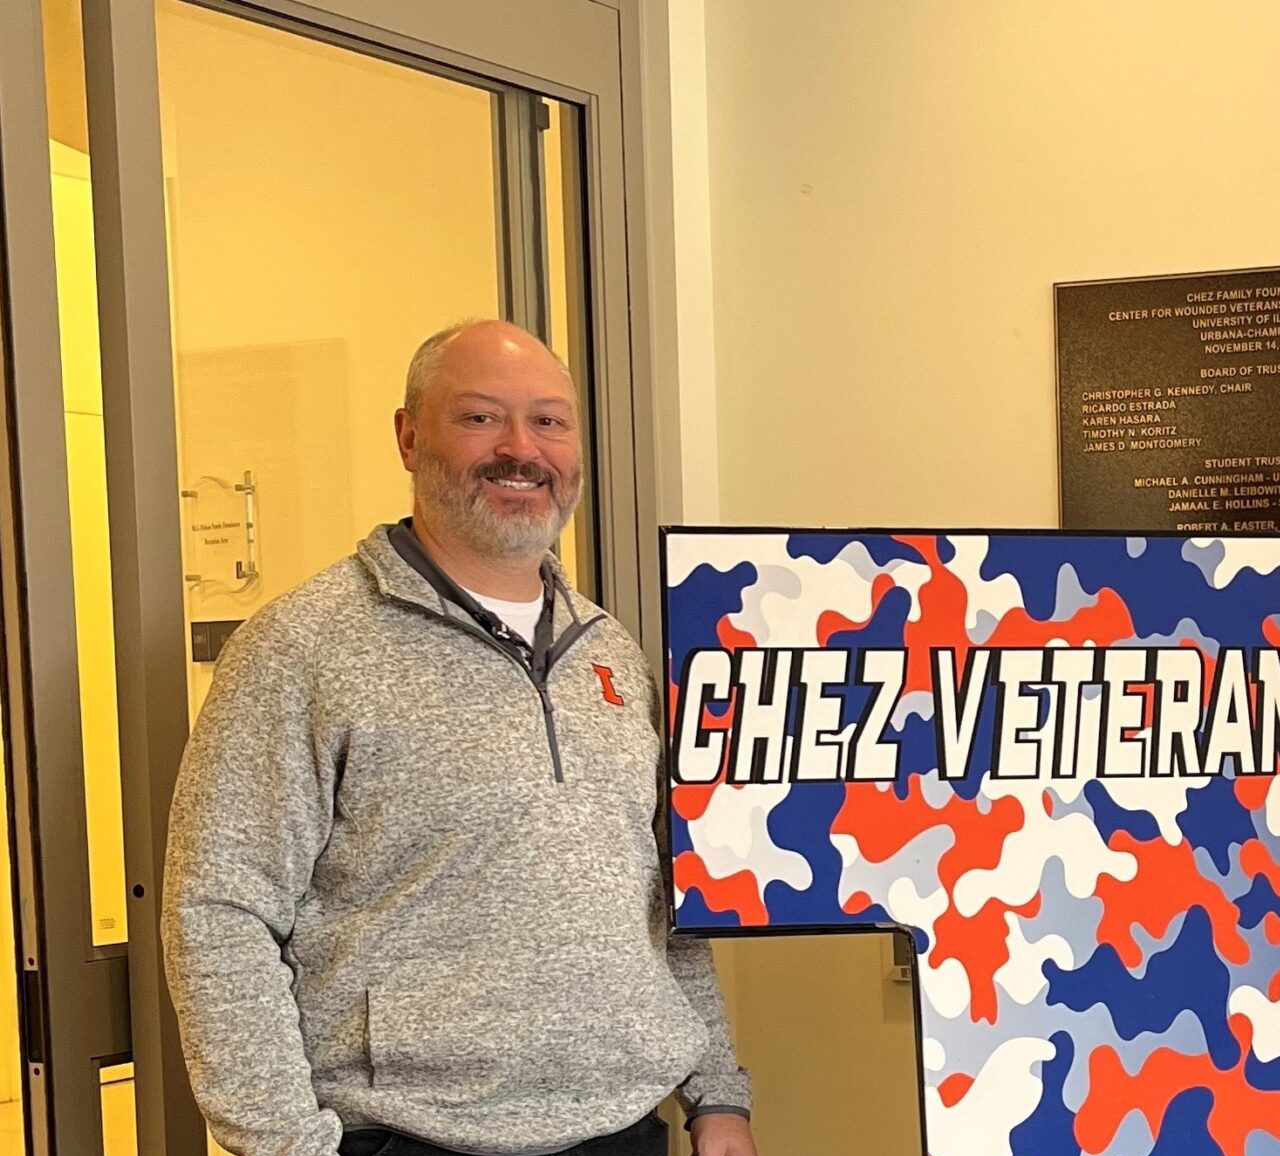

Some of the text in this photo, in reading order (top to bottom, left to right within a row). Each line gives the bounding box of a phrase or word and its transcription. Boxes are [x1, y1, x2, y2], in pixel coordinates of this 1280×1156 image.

[1186, 292, 1214, 303] CHEZ
[1216, 288, 1253, 300] FAMILY
[1108, 309, 1149, 322] CENTER
[1151, 307, 1172, 318] FOR
[1174, 304, 1227, 317] WOUNDED
[1192, 315, 1253, 329] UNIVERSITY
[1255, 314, 1270, 325] OF
[1204, 341, 1263, 354] NOVEMBER
[1265, 340, 1280, 351] 14,
[1200, 366, 1237, 379] BOARD
[1239, 365, 1253, 376] OF
[1081, 388, 1151, 402] CHRISTOPHER
[1220, 382, 1252, 393] CHAIR
[1081, 400, 1177, 414] RICARDO ESTRADA
[1081, 414, 1161, 427] KAREN HASARA
[1082, 428, 1125, 440] TIMOTHY
[1140, 426, 1178, 437] KORITZ
[1083, 441, 1115, 453] JAMES
[1130, 438, 1201, 450] MONTGOMERY
[1204, 457, 1252, 469] STUDENT
[1133, 476, 1179, 488] MICHAEL
[1194, 473, 1264, 485] CUNNINGHAM
[1168, 487, 1217, 499] DANIELLE
[1168, 501, 1210, 512] JAMAAL
[1225, 498, 1270, 510] HOLLINS
[1176, 522, 1218, 531] ROBERT
[1233, 520, 1278, 531] EASTER,
[673, 647, 908, 784] CHEZ
